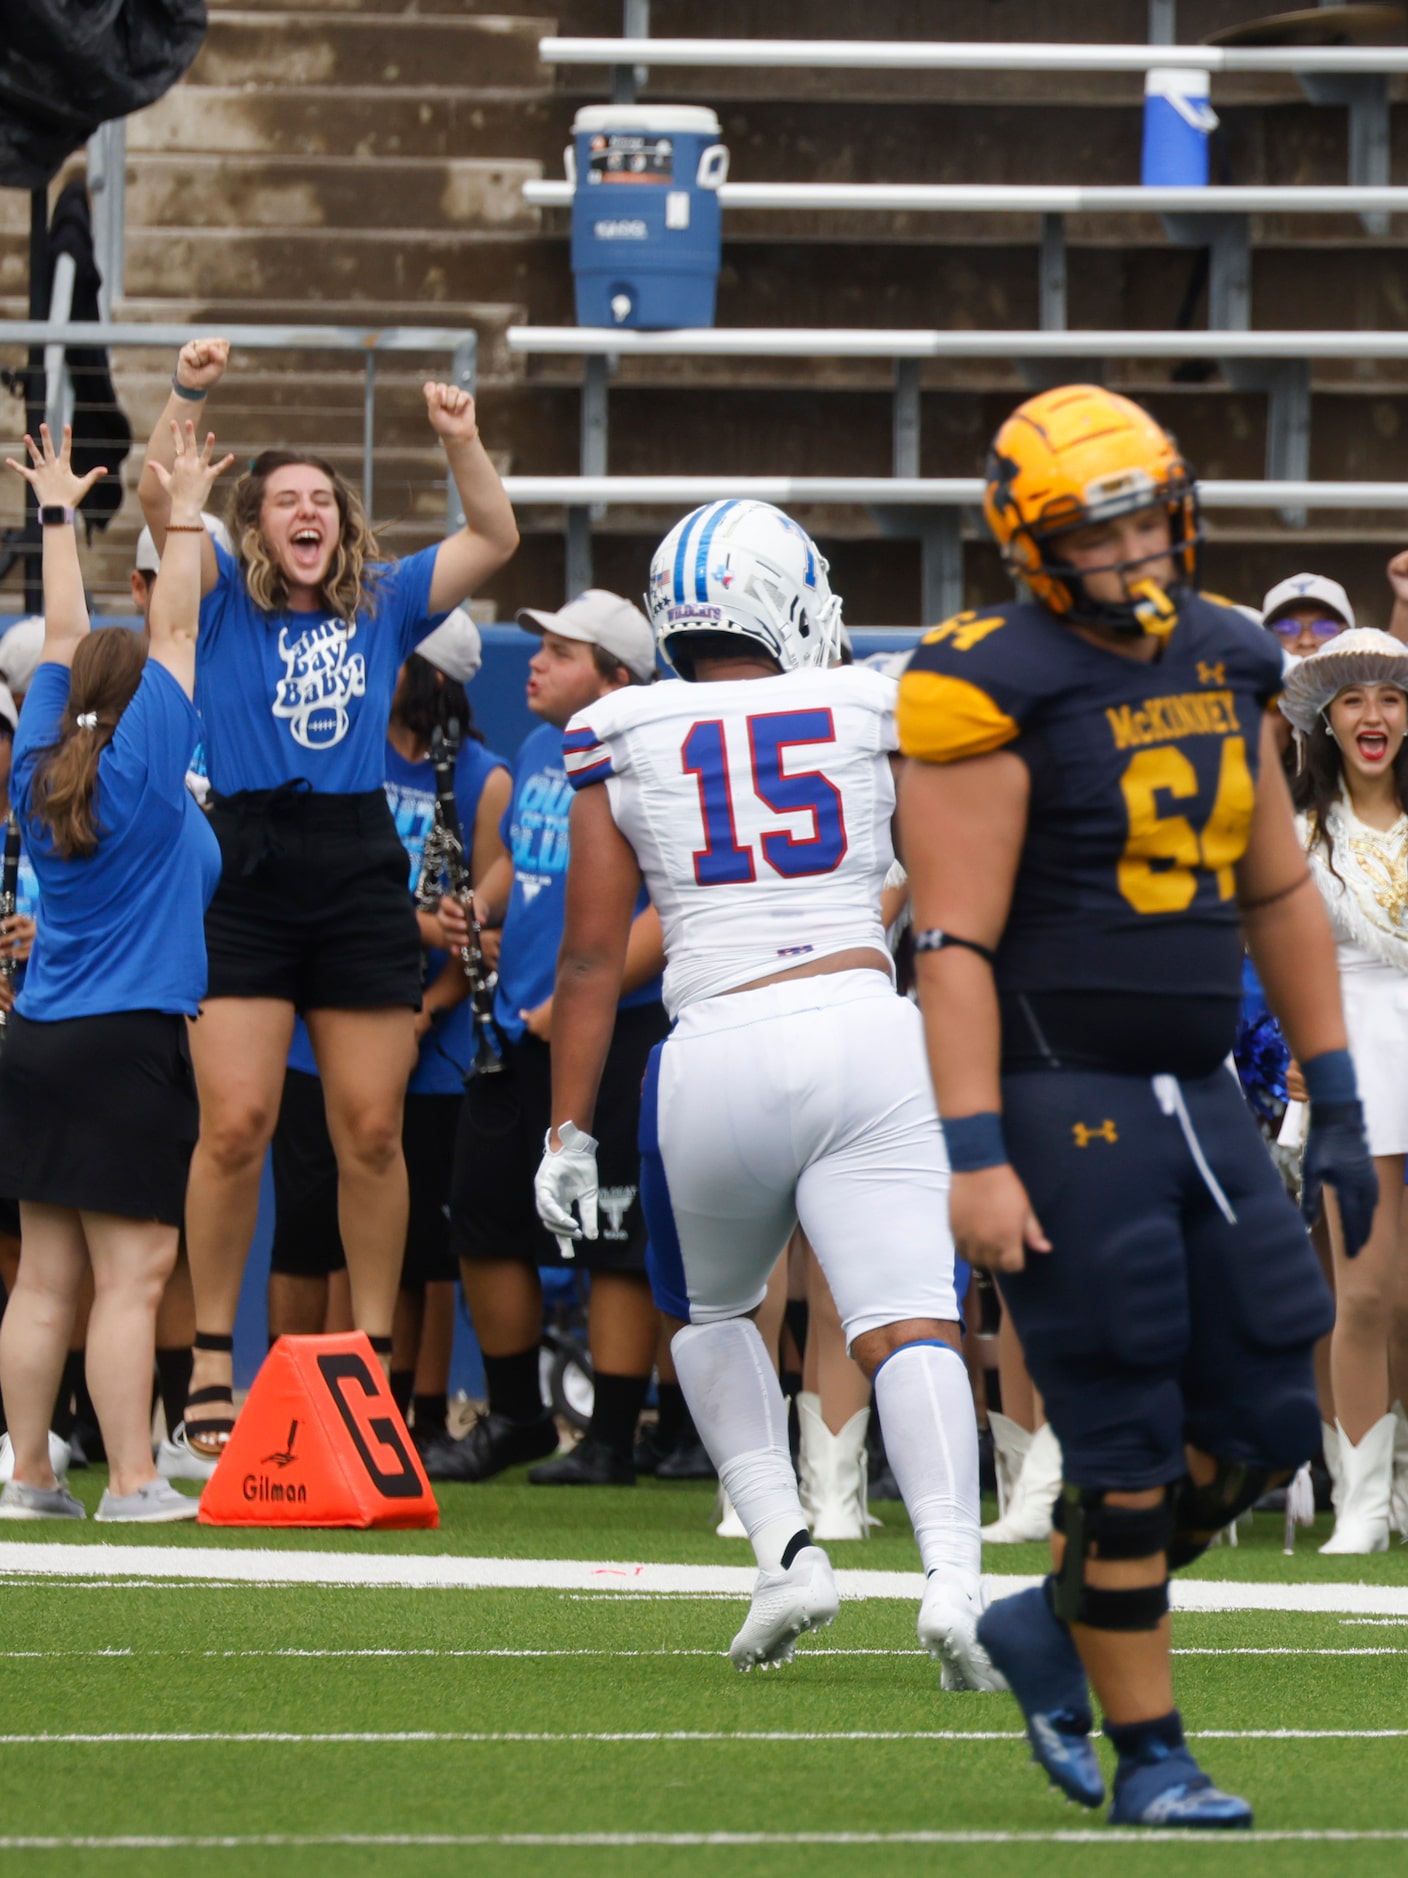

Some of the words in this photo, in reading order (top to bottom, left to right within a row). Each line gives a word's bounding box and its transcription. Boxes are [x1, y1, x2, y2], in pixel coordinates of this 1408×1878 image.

[667, 604, 722, 624] WILDCATS
[272, 651, 366, 718] Baby!
[681, 707, 849, 888] 15
[1116, 736, 1256, 915] 64
[316, 1352, 424, 1499] G
[242, 1474, 308, 1504] Gilman
